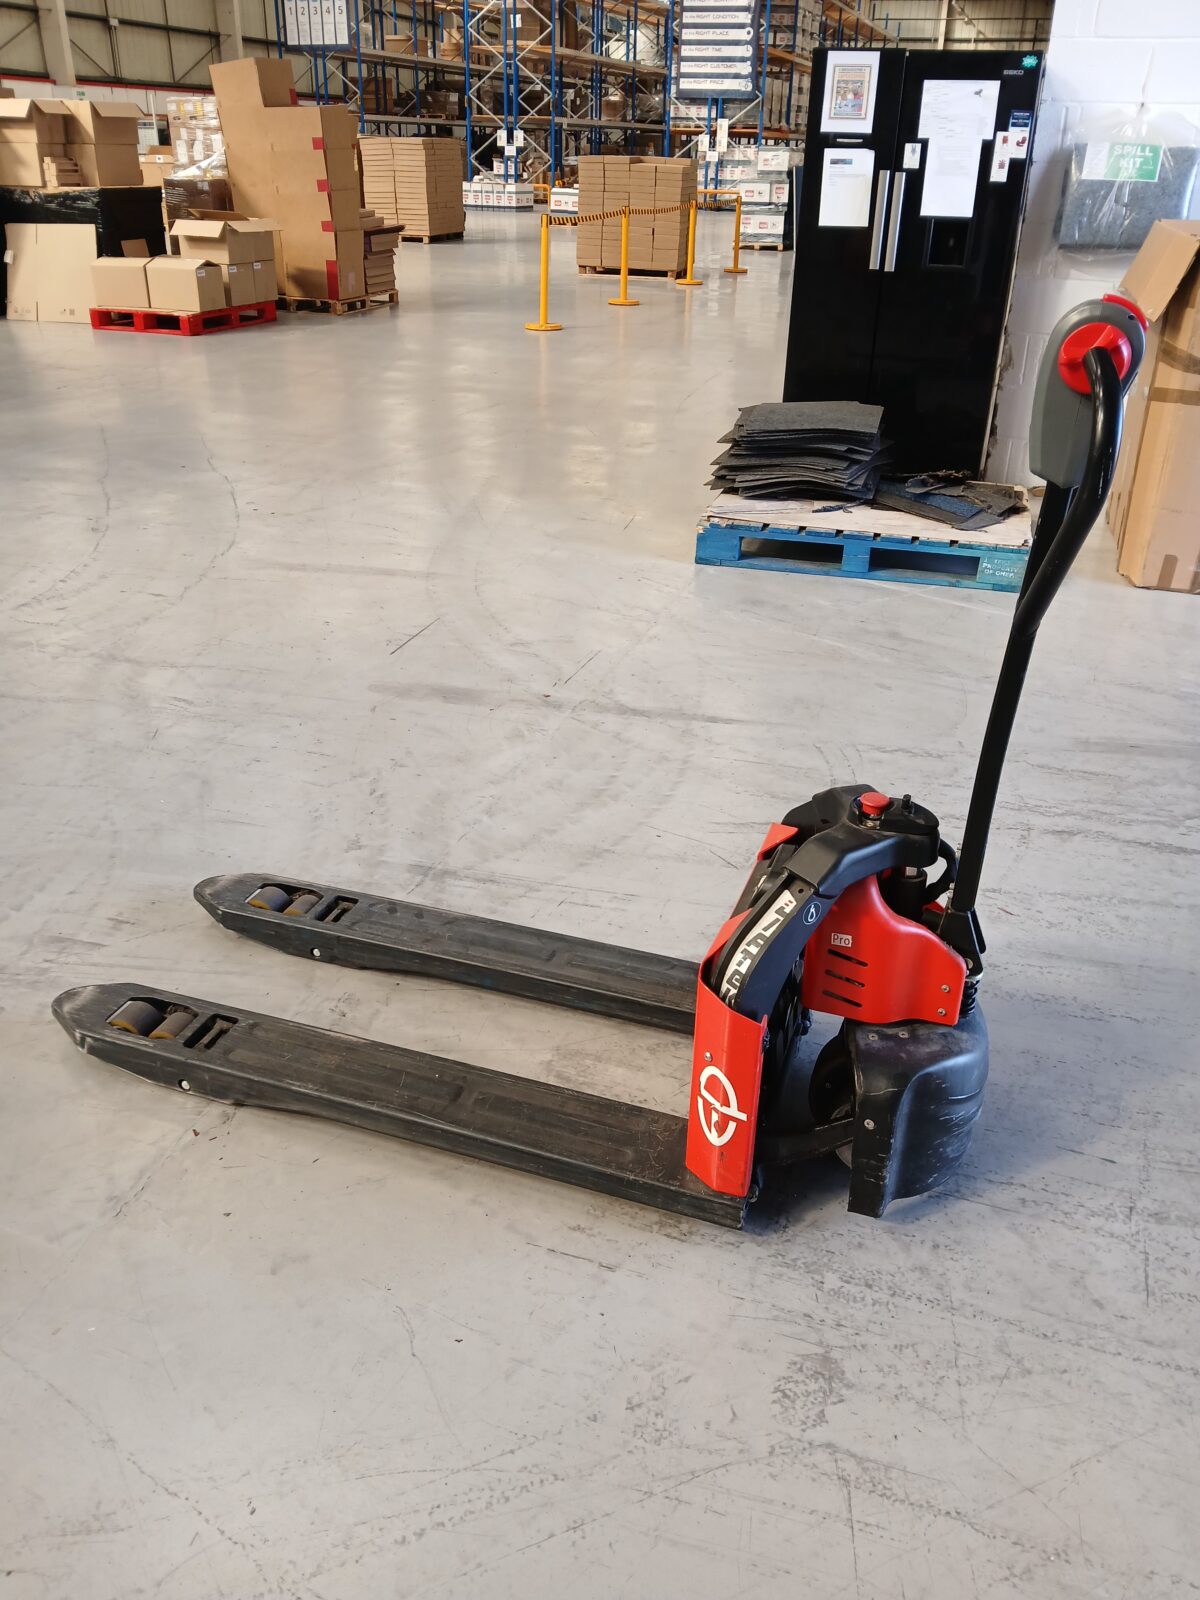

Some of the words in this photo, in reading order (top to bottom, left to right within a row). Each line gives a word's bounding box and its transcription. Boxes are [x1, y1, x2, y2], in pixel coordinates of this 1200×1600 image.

[301, 6, 305, 15] 2
[313, 6, 318, 15] 3
[325, 6, 331, 15] 4
[337, 6, 343, 15] 5
[1113, 145, 1153, 156] SPILL
[1120, 158, 1144, 168] KIT
[833, 934, 850, 945] Pro
